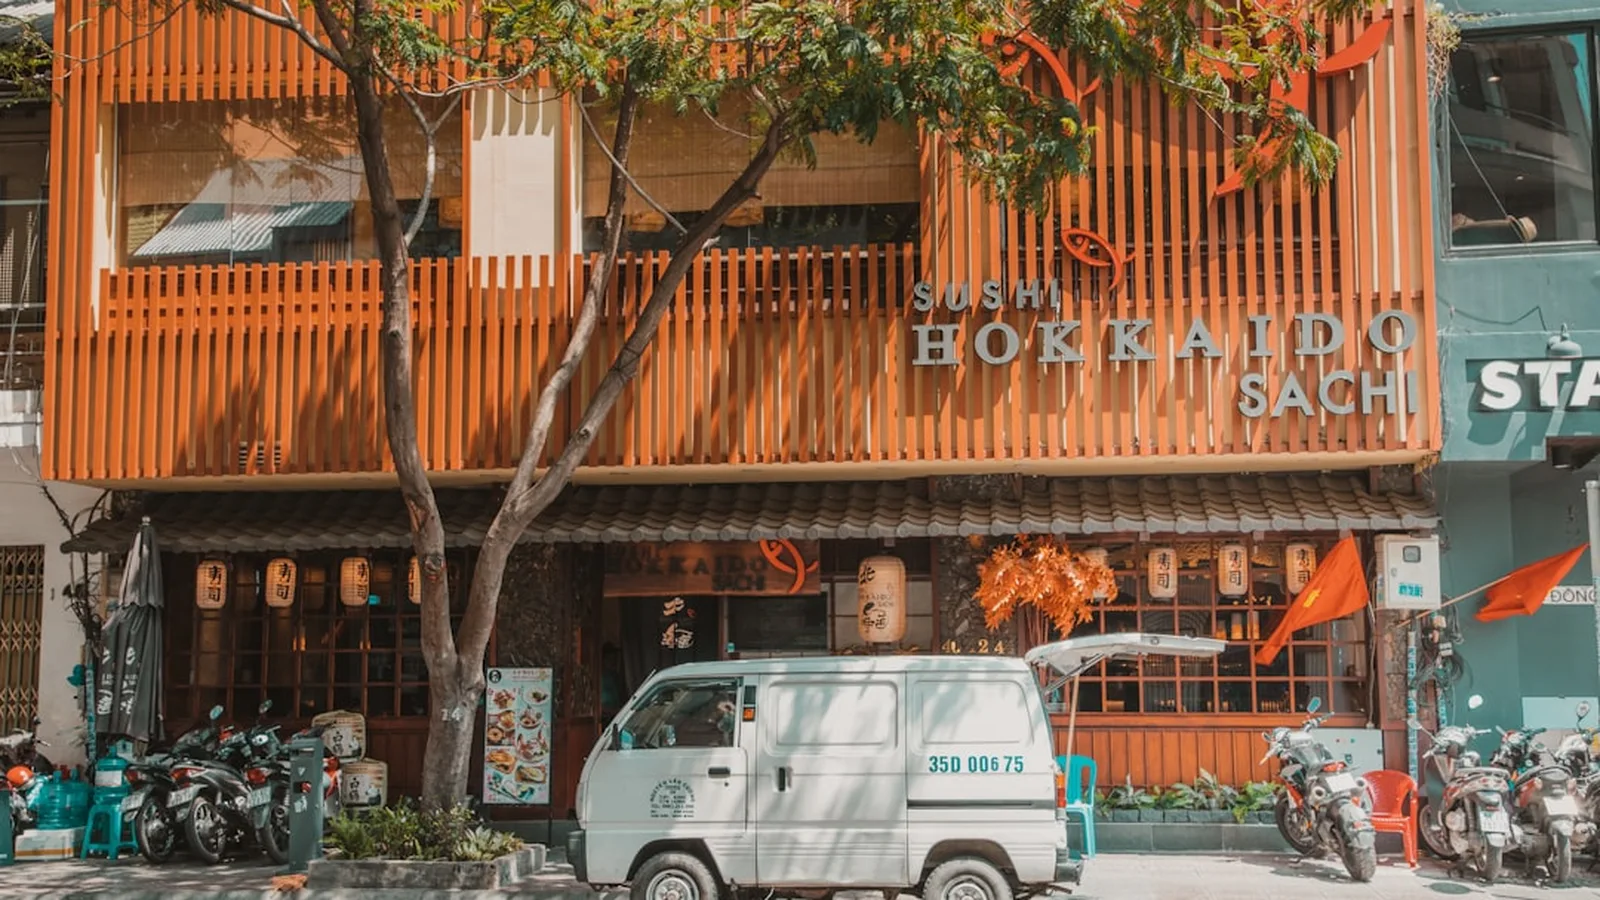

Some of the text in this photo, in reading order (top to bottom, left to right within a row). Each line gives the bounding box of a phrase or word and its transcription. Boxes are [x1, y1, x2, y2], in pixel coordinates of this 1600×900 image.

[913, 278, 1058, 312] SUSHI
[911, 308, 1417, 366] HOKKAIDO
[1237, 369, 1418, 418] SACHI
[928, 755, 961, 773] 35D
